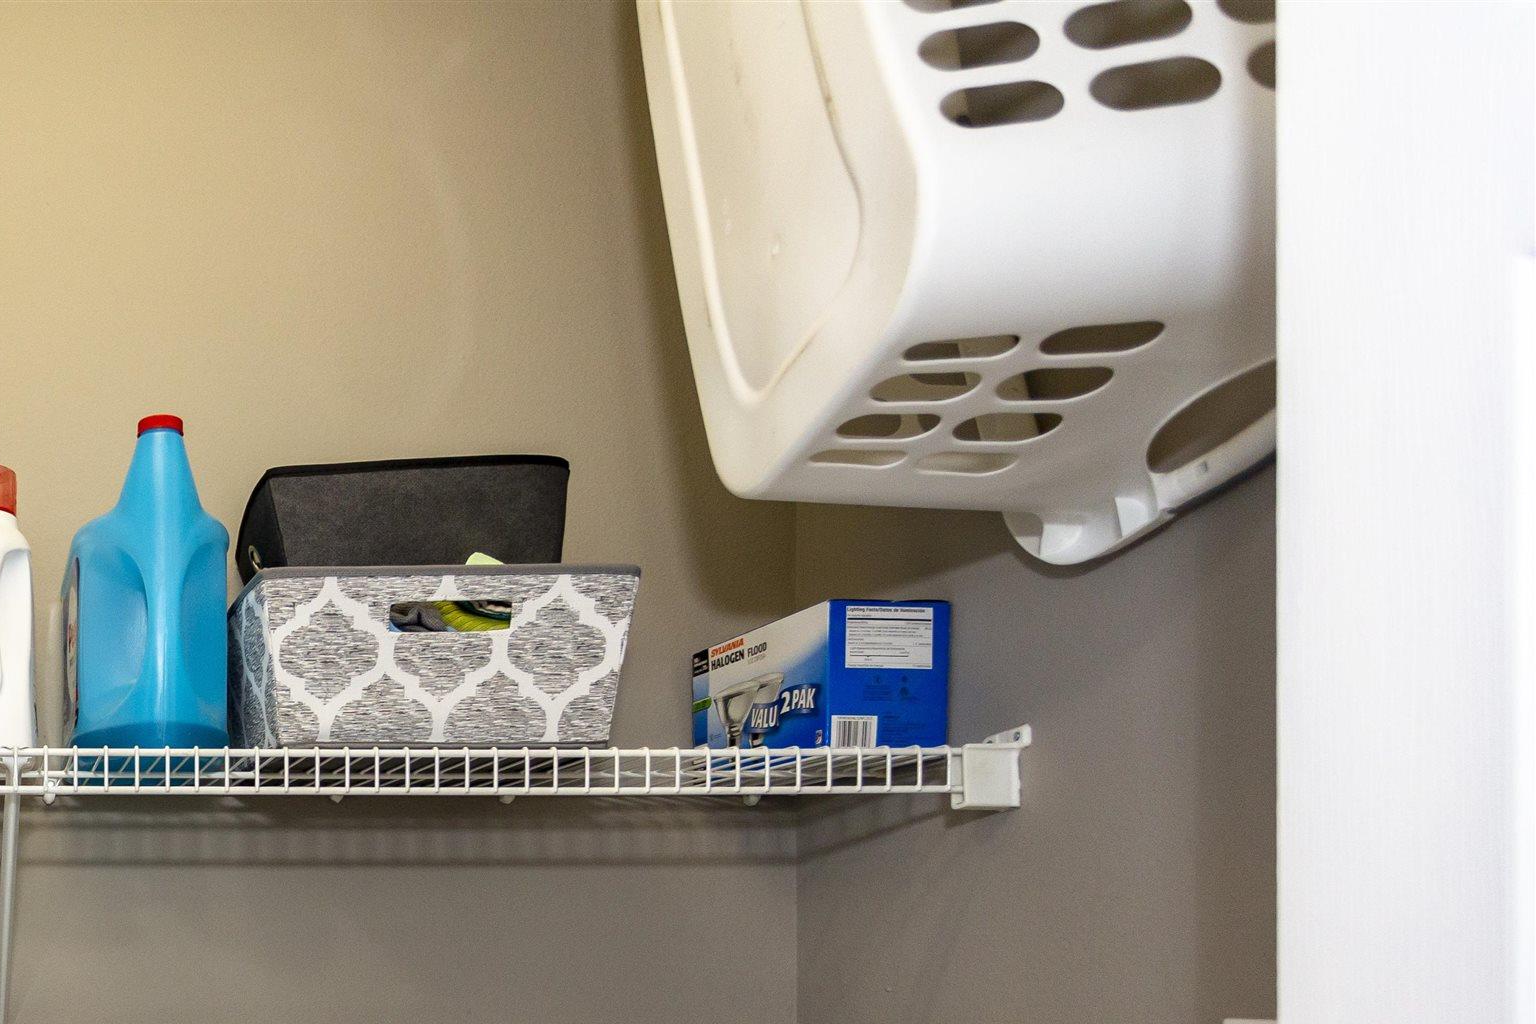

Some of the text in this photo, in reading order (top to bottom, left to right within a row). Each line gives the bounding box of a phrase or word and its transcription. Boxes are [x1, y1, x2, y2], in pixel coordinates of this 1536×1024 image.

[710, 638, 744, 658] SYLVANIA
[710, 649, 745, 671] HALOGEN
[747, 641, 768, 658] FLOOD
[750, 688, 816, 728] VALU 2 PAK
